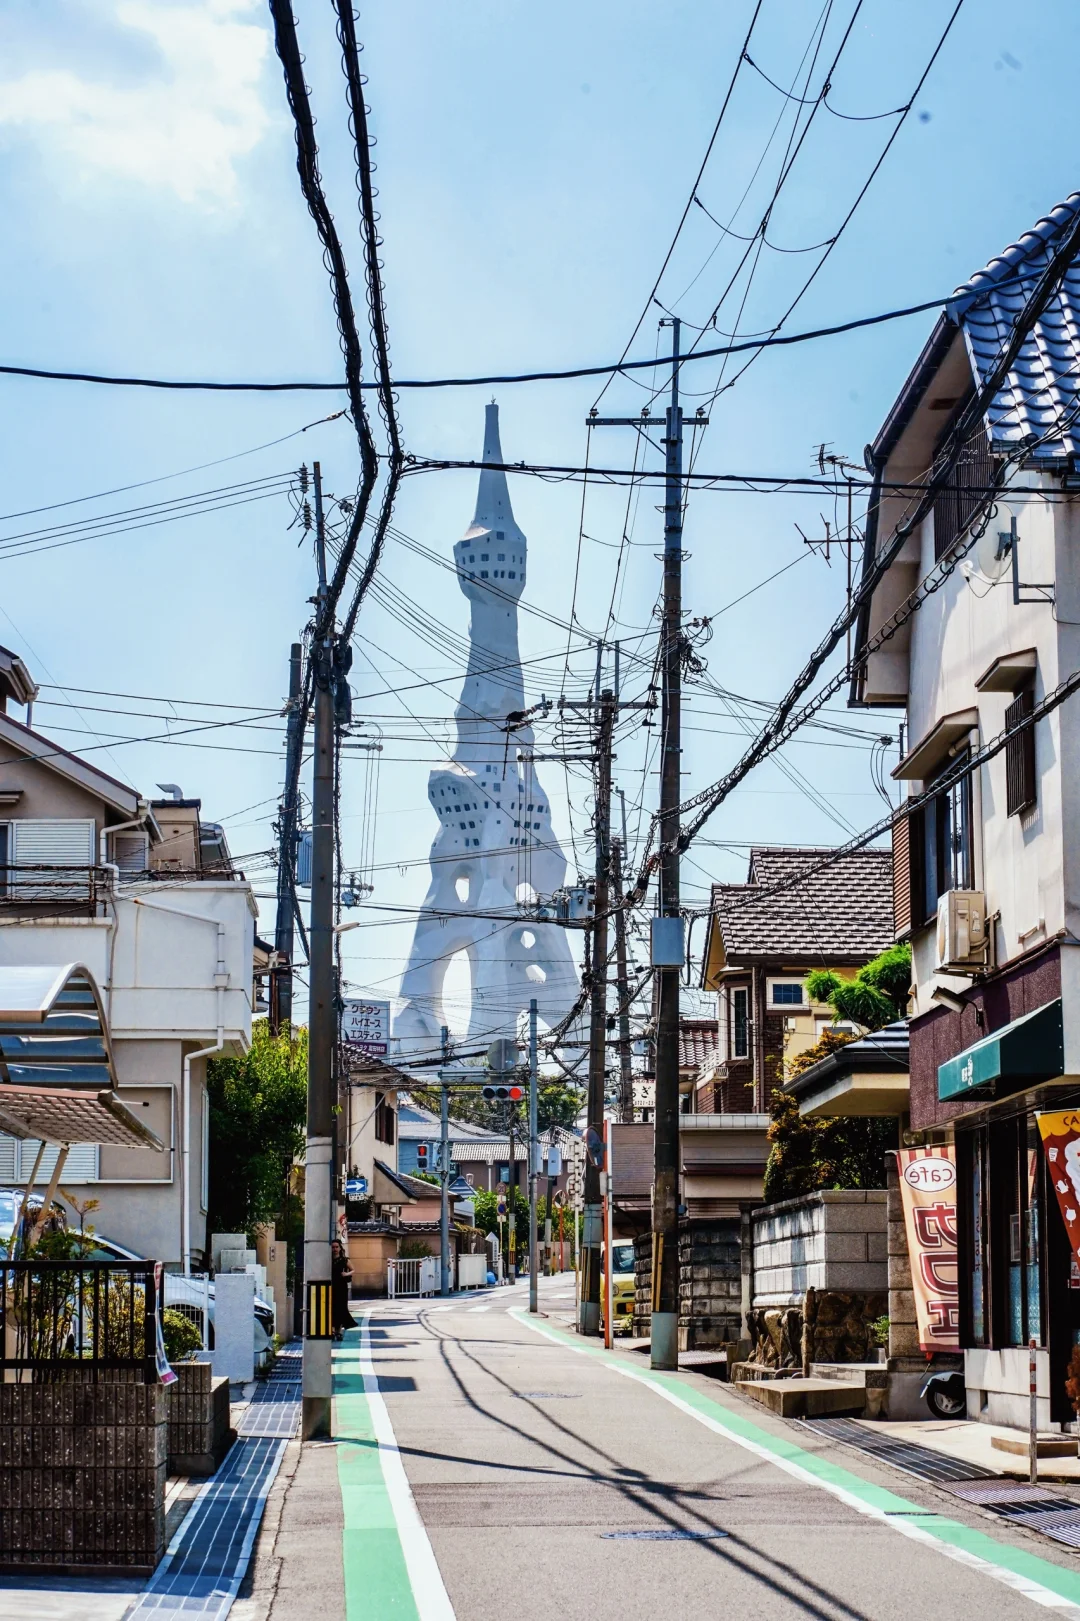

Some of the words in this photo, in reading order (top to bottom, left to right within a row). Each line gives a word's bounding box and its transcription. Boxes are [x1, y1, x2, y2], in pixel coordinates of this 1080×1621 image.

[351, 1004, 380, 1015] クラウン
[351, 1017, 381, 1028] ハイエース
[350, 1029, 381, 1040] エスティマ
[1063, 1115, 1079, 1126] CA
